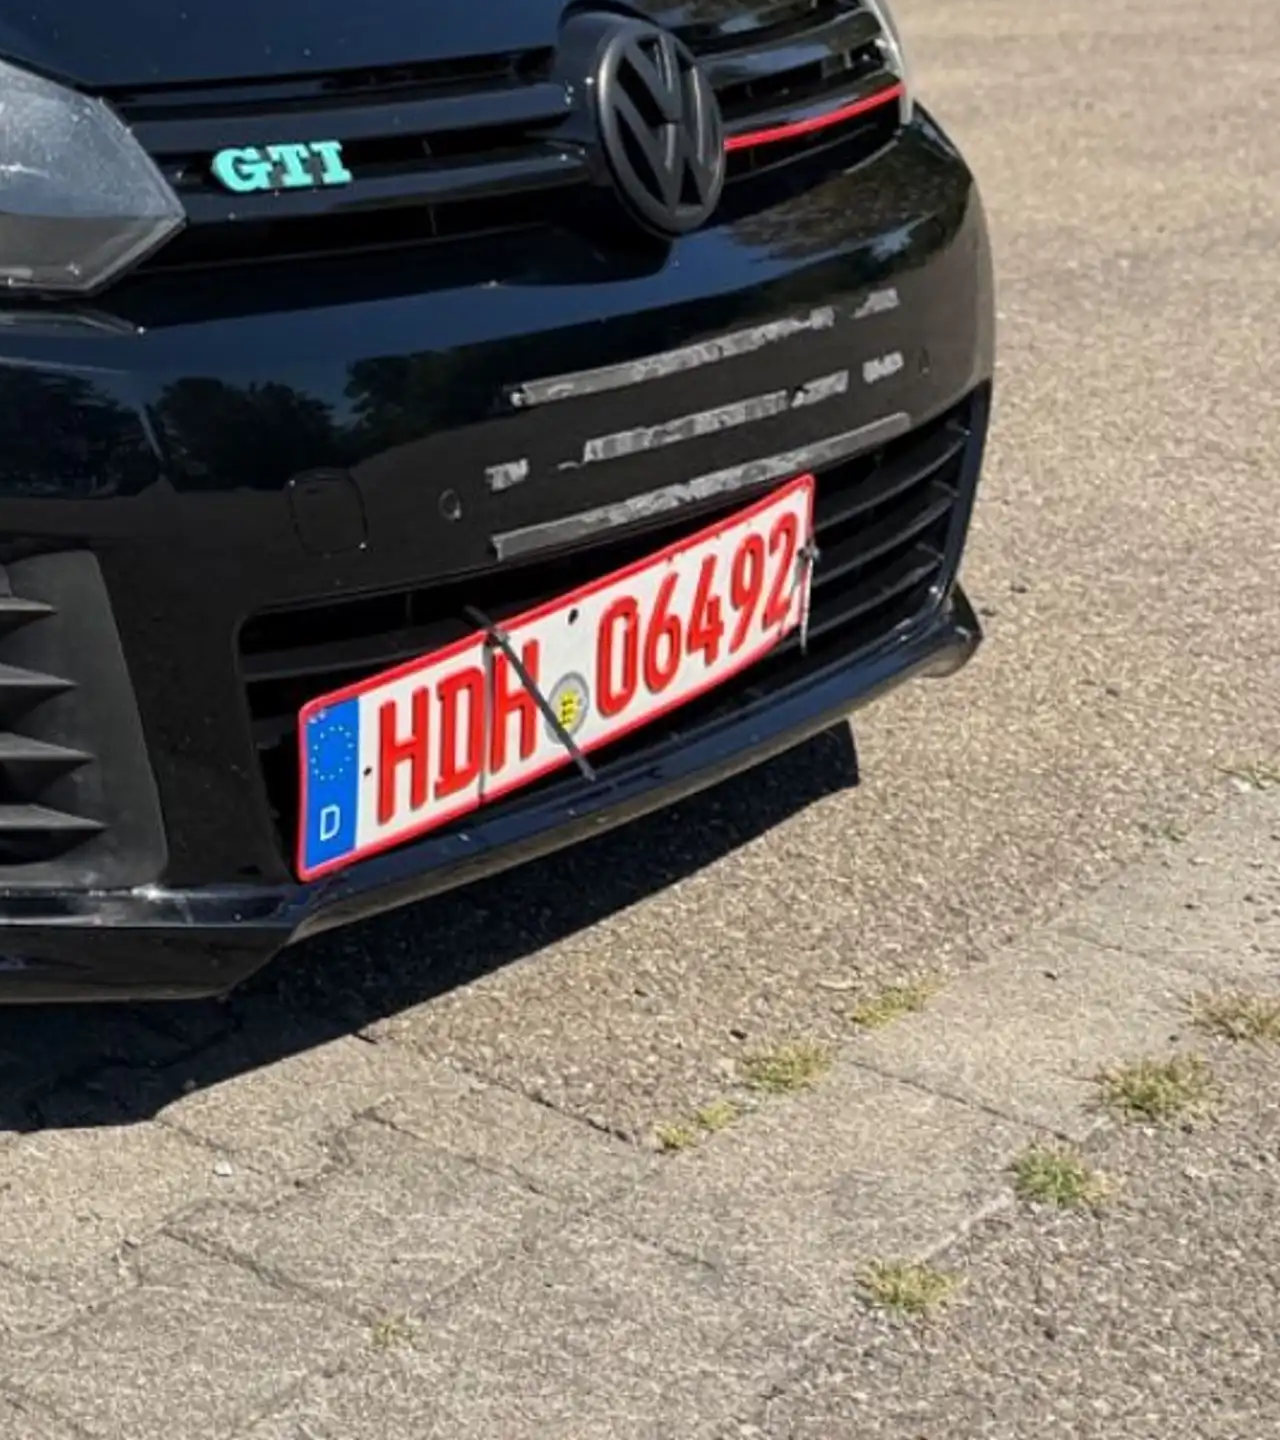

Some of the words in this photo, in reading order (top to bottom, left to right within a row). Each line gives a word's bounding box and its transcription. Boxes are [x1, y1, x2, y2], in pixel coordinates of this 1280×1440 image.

[211, 138, 353, 193] GTI
[377, 638, 539, 827] HDH
[596, 511, 798, 719] 06492
[319, 803, 341, 841] D
